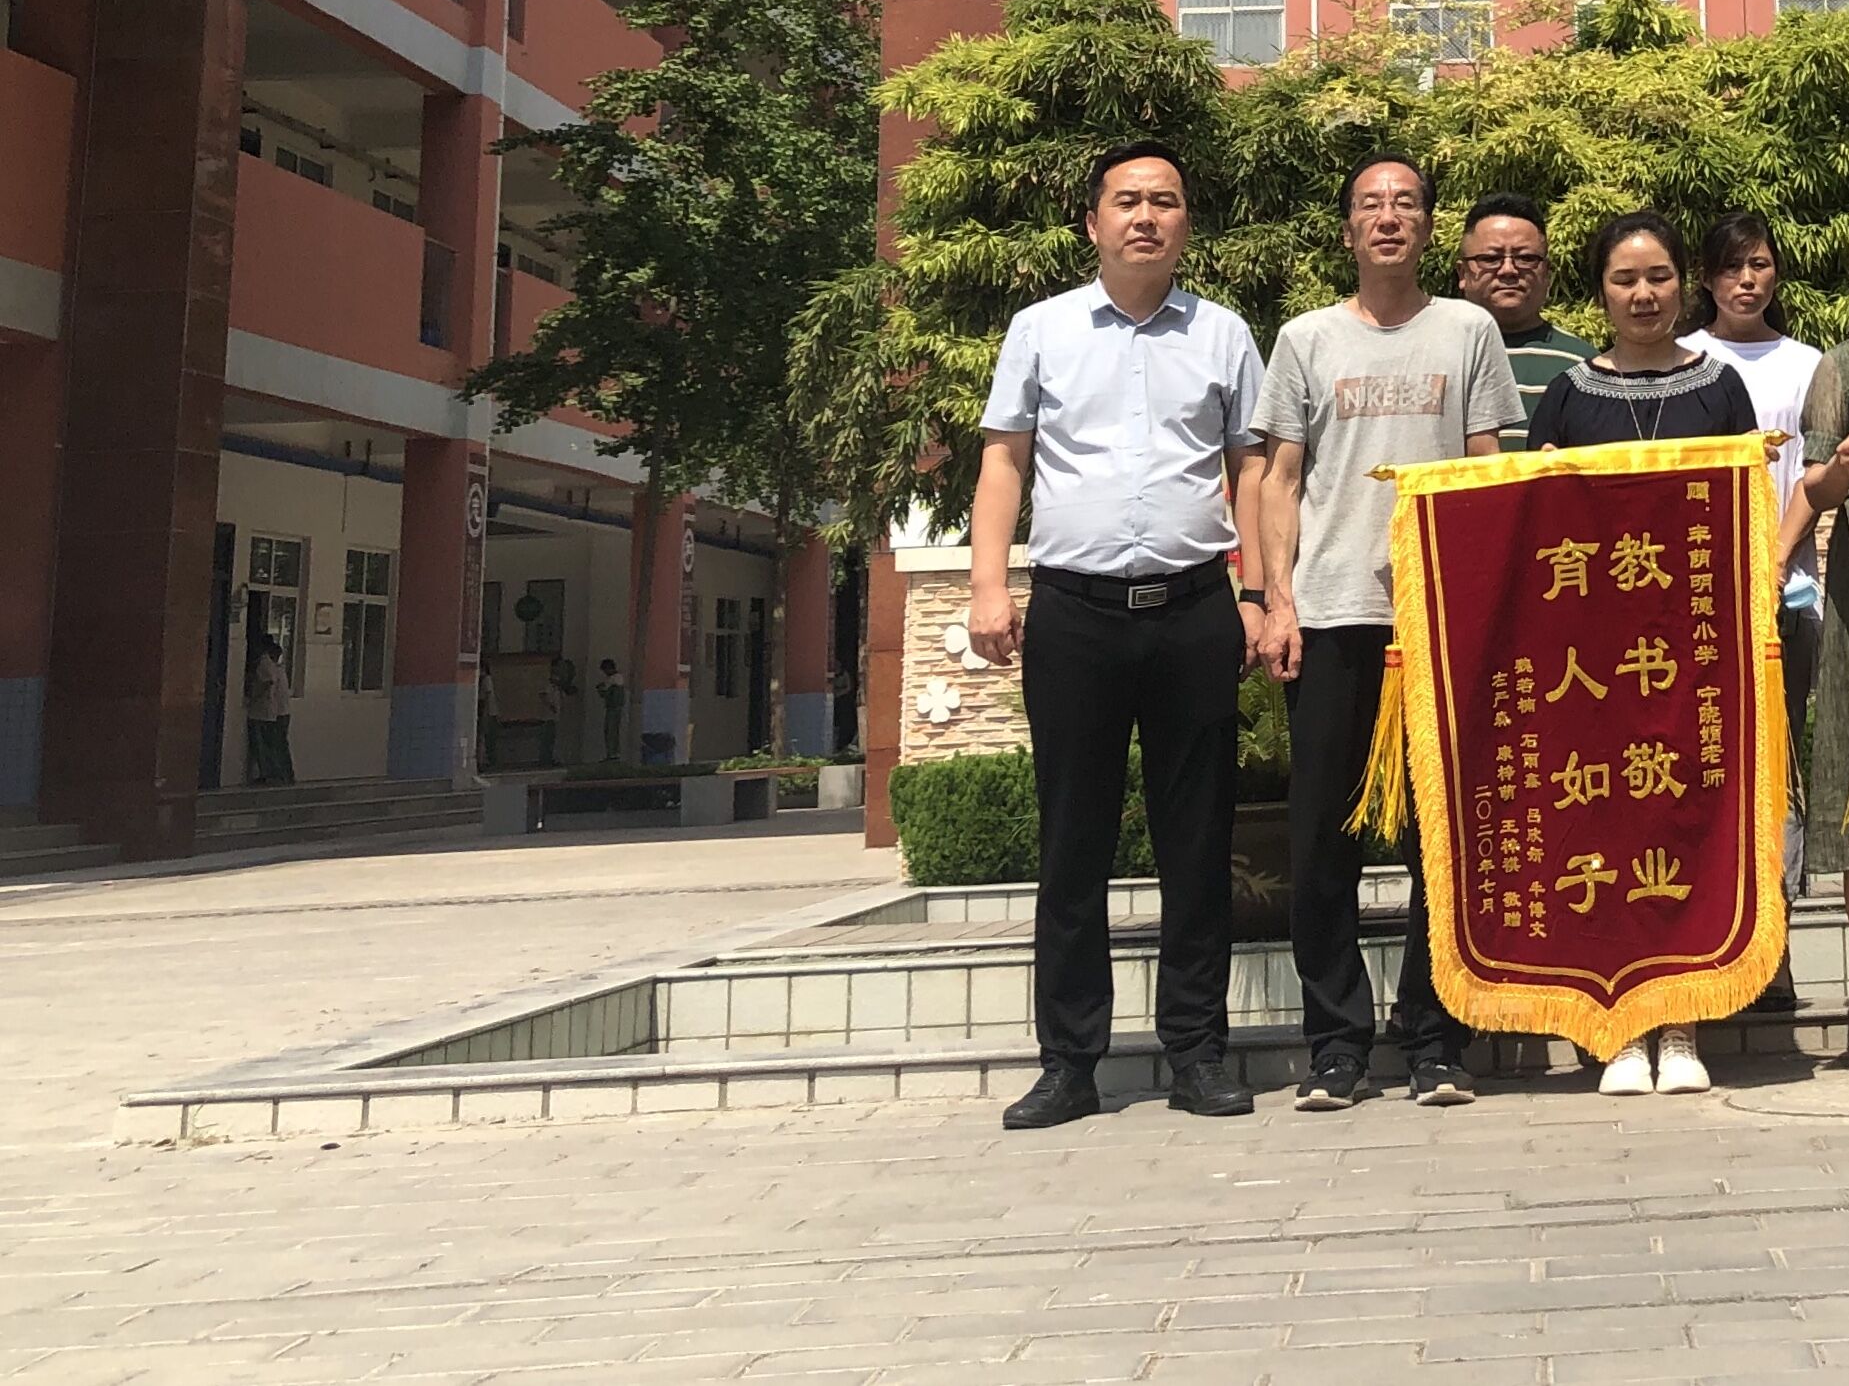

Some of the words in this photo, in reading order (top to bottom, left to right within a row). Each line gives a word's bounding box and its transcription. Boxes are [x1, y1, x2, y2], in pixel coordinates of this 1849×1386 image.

[1535, 538, 1619, 914] 育人如子
[1608, 531, 1693, 903] 教书敬业
